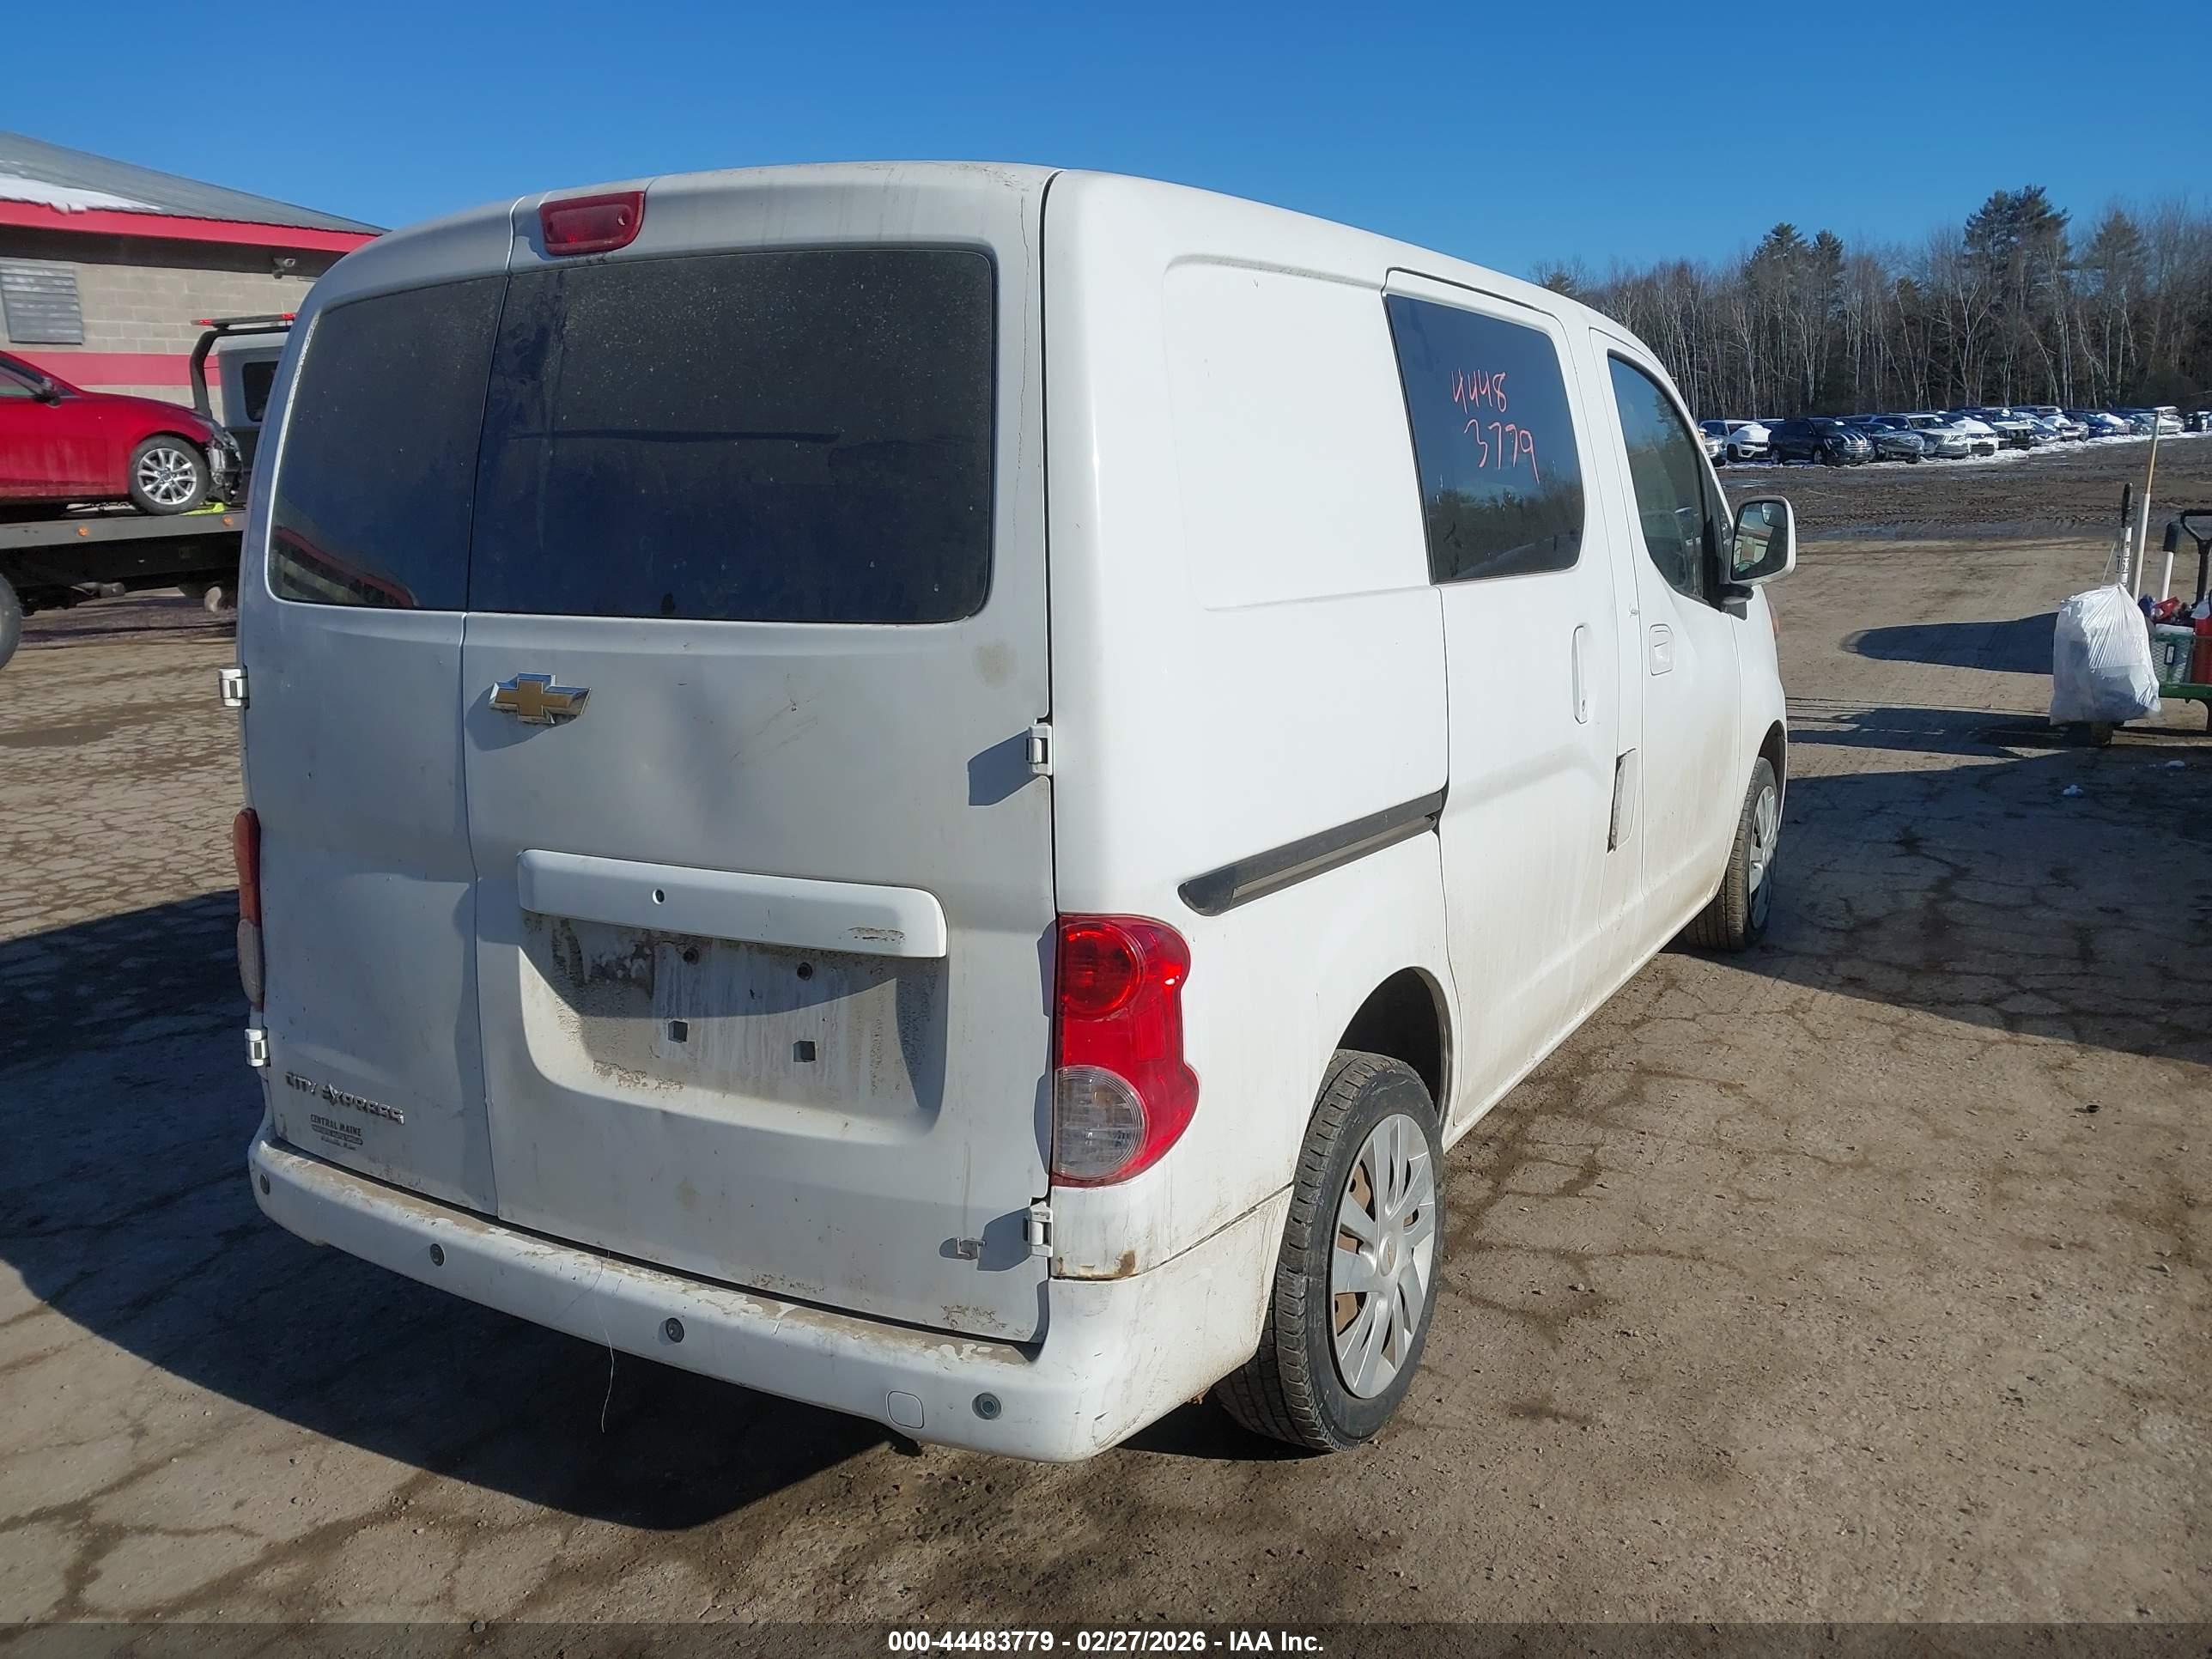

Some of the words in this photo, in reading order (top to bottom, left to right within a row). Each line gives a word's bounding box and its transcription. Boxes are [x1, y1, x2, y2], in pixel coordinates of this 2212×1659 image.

[1451, 368, 1507, 414] 4448
[1464, 418, 1540, 484] 3779
[310, 1114, 337, 1130] CENTRAL
[339, 1123, 362, 1137] MAINE
